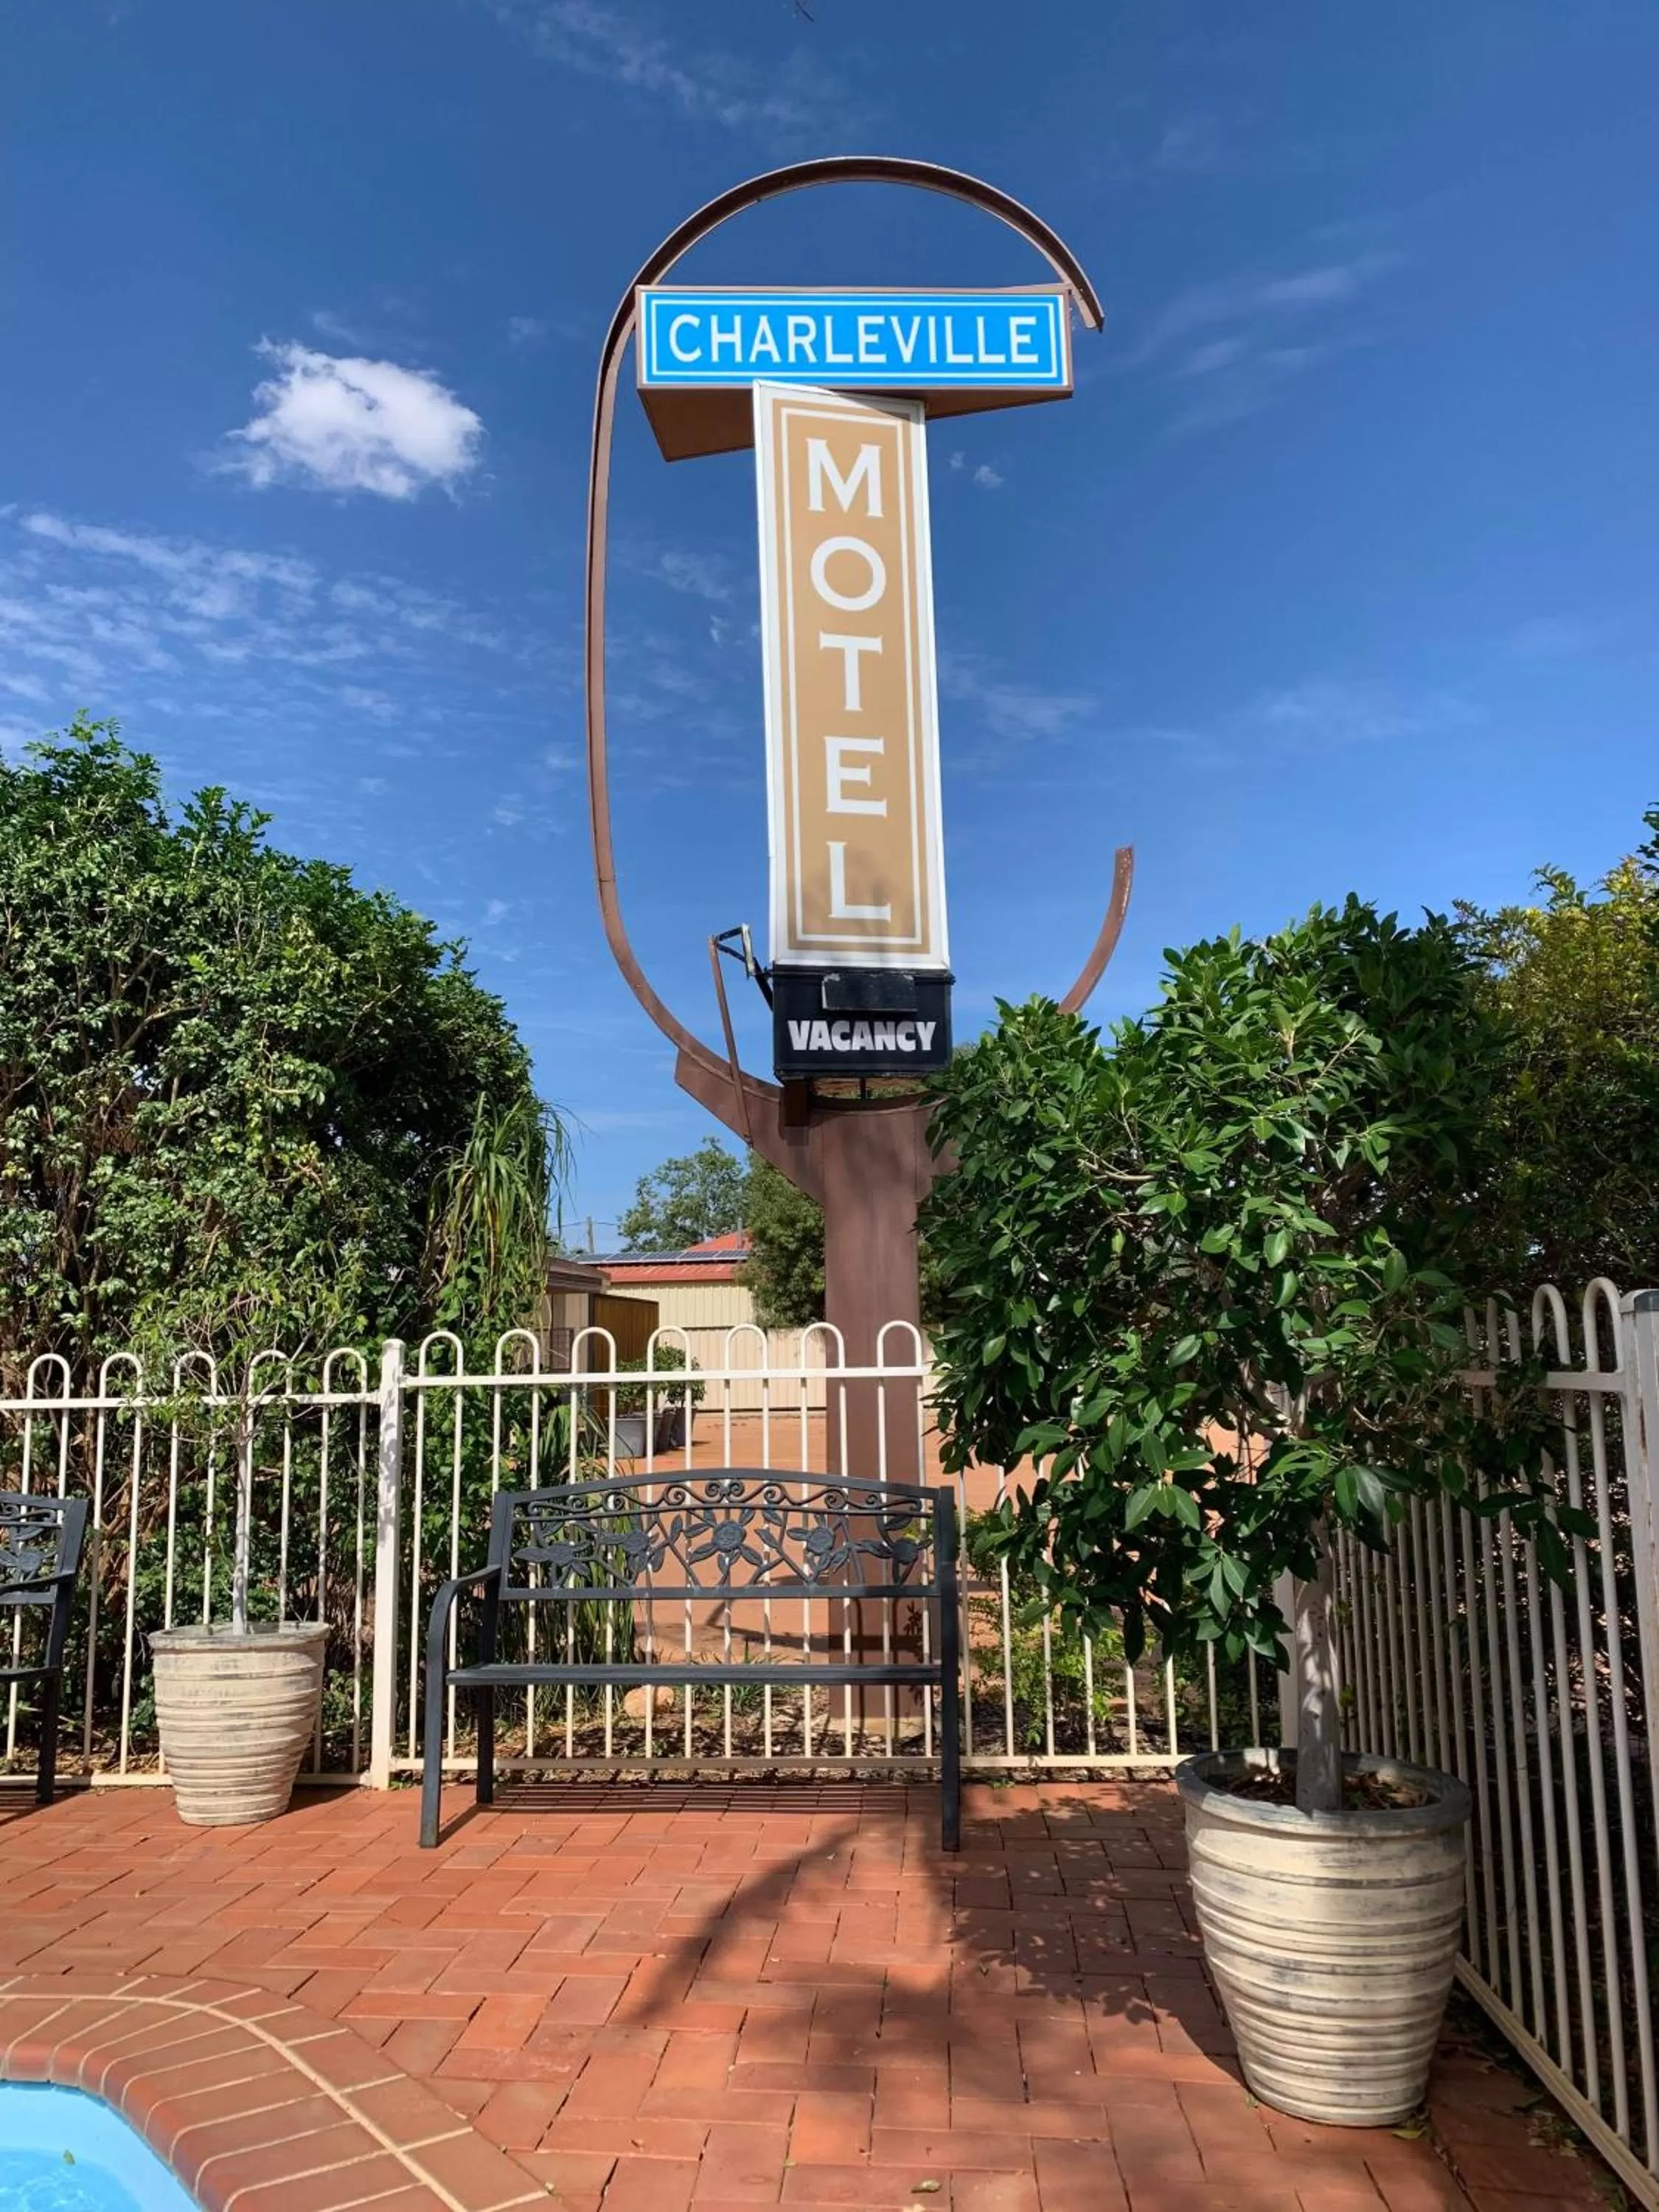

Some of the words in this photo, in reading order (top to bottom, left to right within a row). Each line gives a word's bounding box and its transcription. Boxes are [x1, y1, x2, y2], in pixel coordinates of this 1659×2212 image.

[669, 313, 1039, 364] CHARLEVILLE
[806, 437, 891, 922] MOTEL
[787, 1020, 936, 1052] VACANCY
